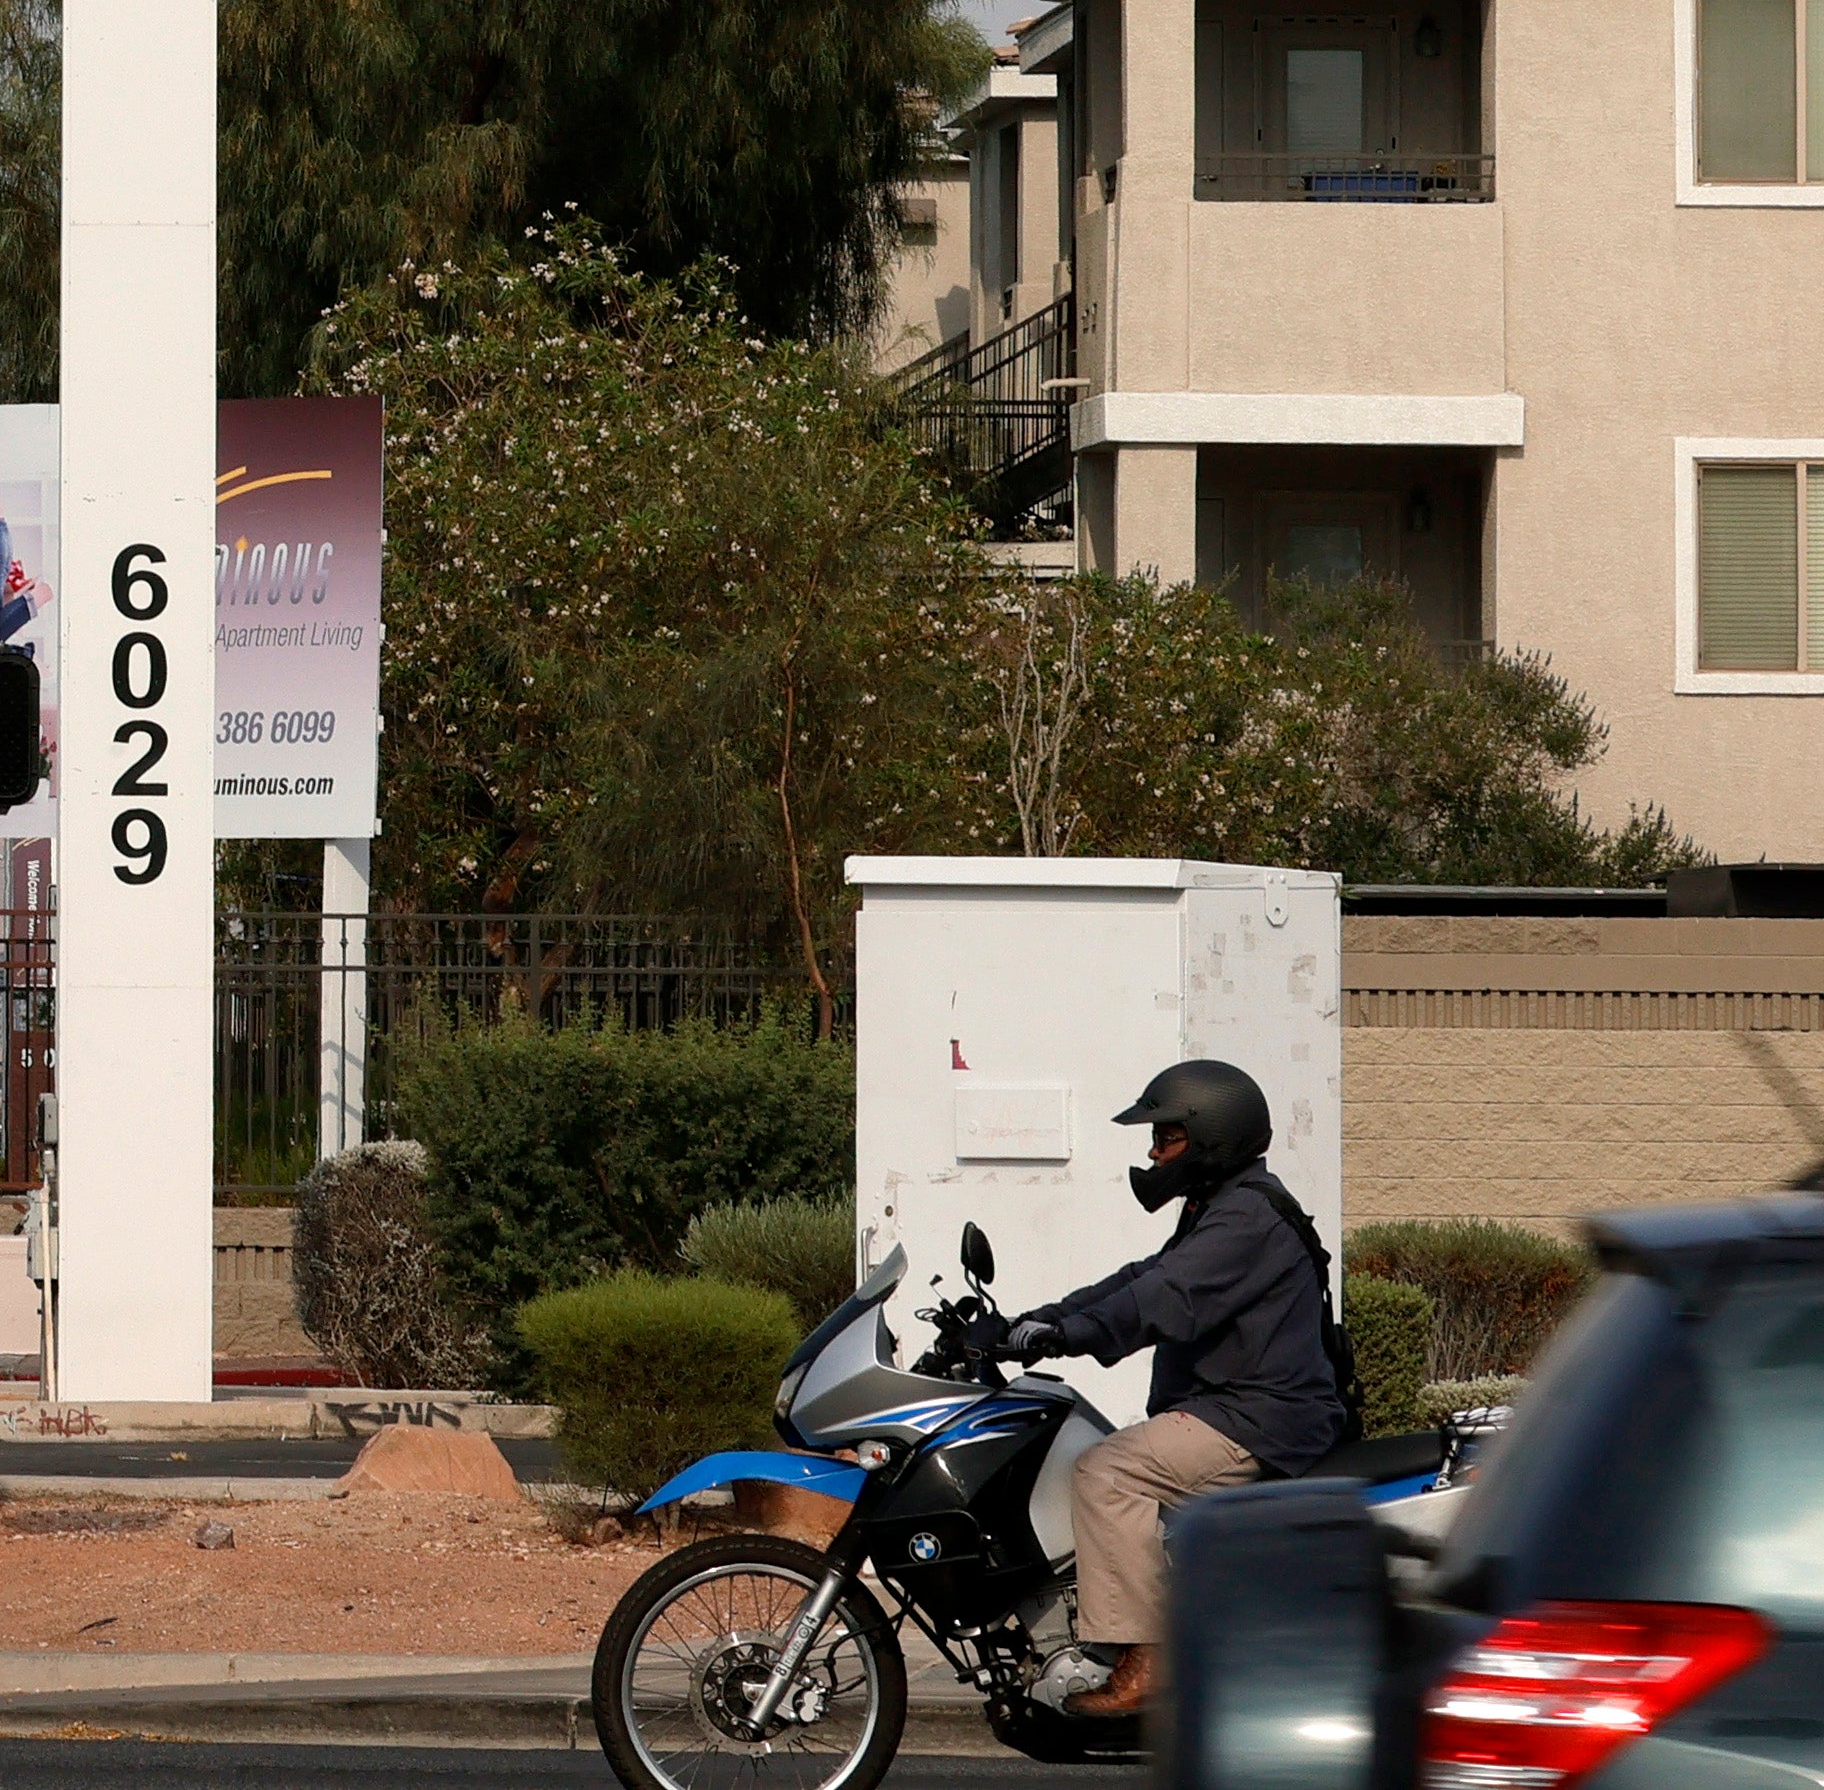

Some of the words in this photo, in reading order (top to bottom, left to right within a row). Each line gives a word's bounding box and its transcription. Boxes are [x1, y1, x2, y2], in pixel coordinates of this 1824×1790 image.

[216, 623, 306, 652] Apartment
[311, 623, 363, 651] Living
[110, 544, 169, 885] 6029
[216, 711, 264, 744] 386
[270, 711, 336, 744] 6099
[27, 860, 40, 911] Welcome
